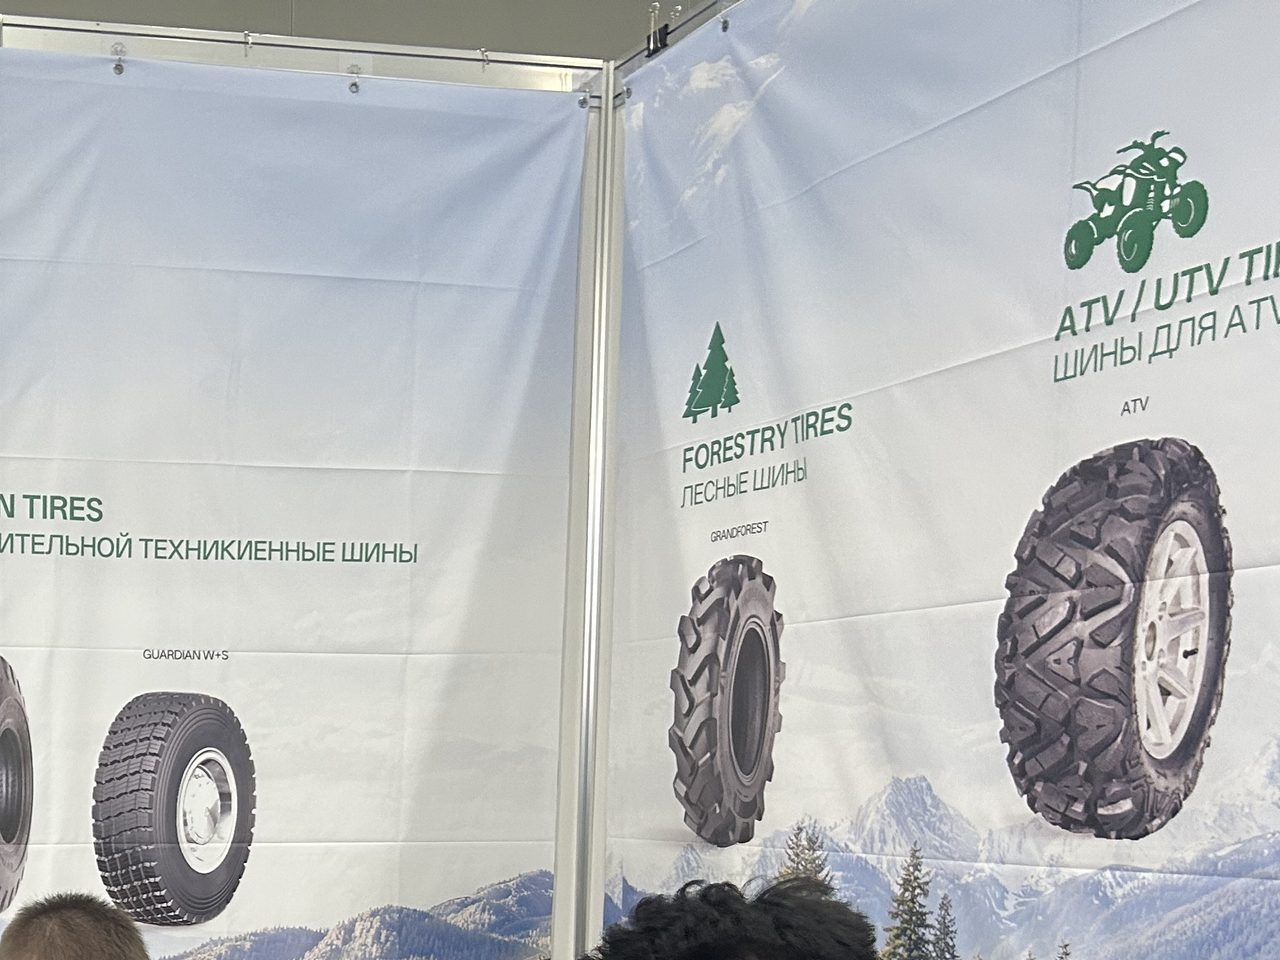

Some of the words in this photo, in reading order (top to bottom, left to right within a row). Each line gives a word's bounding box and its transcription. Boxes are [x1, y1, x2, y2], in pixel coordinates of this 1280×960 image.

[1055, 289, 1125, 341] ATV
[1131, 280, 1146, 322] /
[1154, 257, 1230, 310] UTV
[1239, 241, 1280, 286] TI
[1054, 332, 1142, 383] ШИНЫ
[1148, 311, 1216, 364] ДЛЯ
[1121, 396, 1149, 416] ATV
[683, 421, 788, 473] FORESTRY
[791, 403, 852, 444] TIRES
[681, 471, 748, 508] ЛЕСНЫЕ
[753, 457, 807, 491] ШИНЫ
[23, 495, 103, 522] TIRES
[711, 521, 768, 542] GRANDFOREST
[139, 539, 335, 562] ТЕХНИКИЕННЫЕ
[342, 543, 417, 563] ШИНЫ
[143, 649, 200, 660] GUARDIAN
[203, 650, 228, 660] W+S
